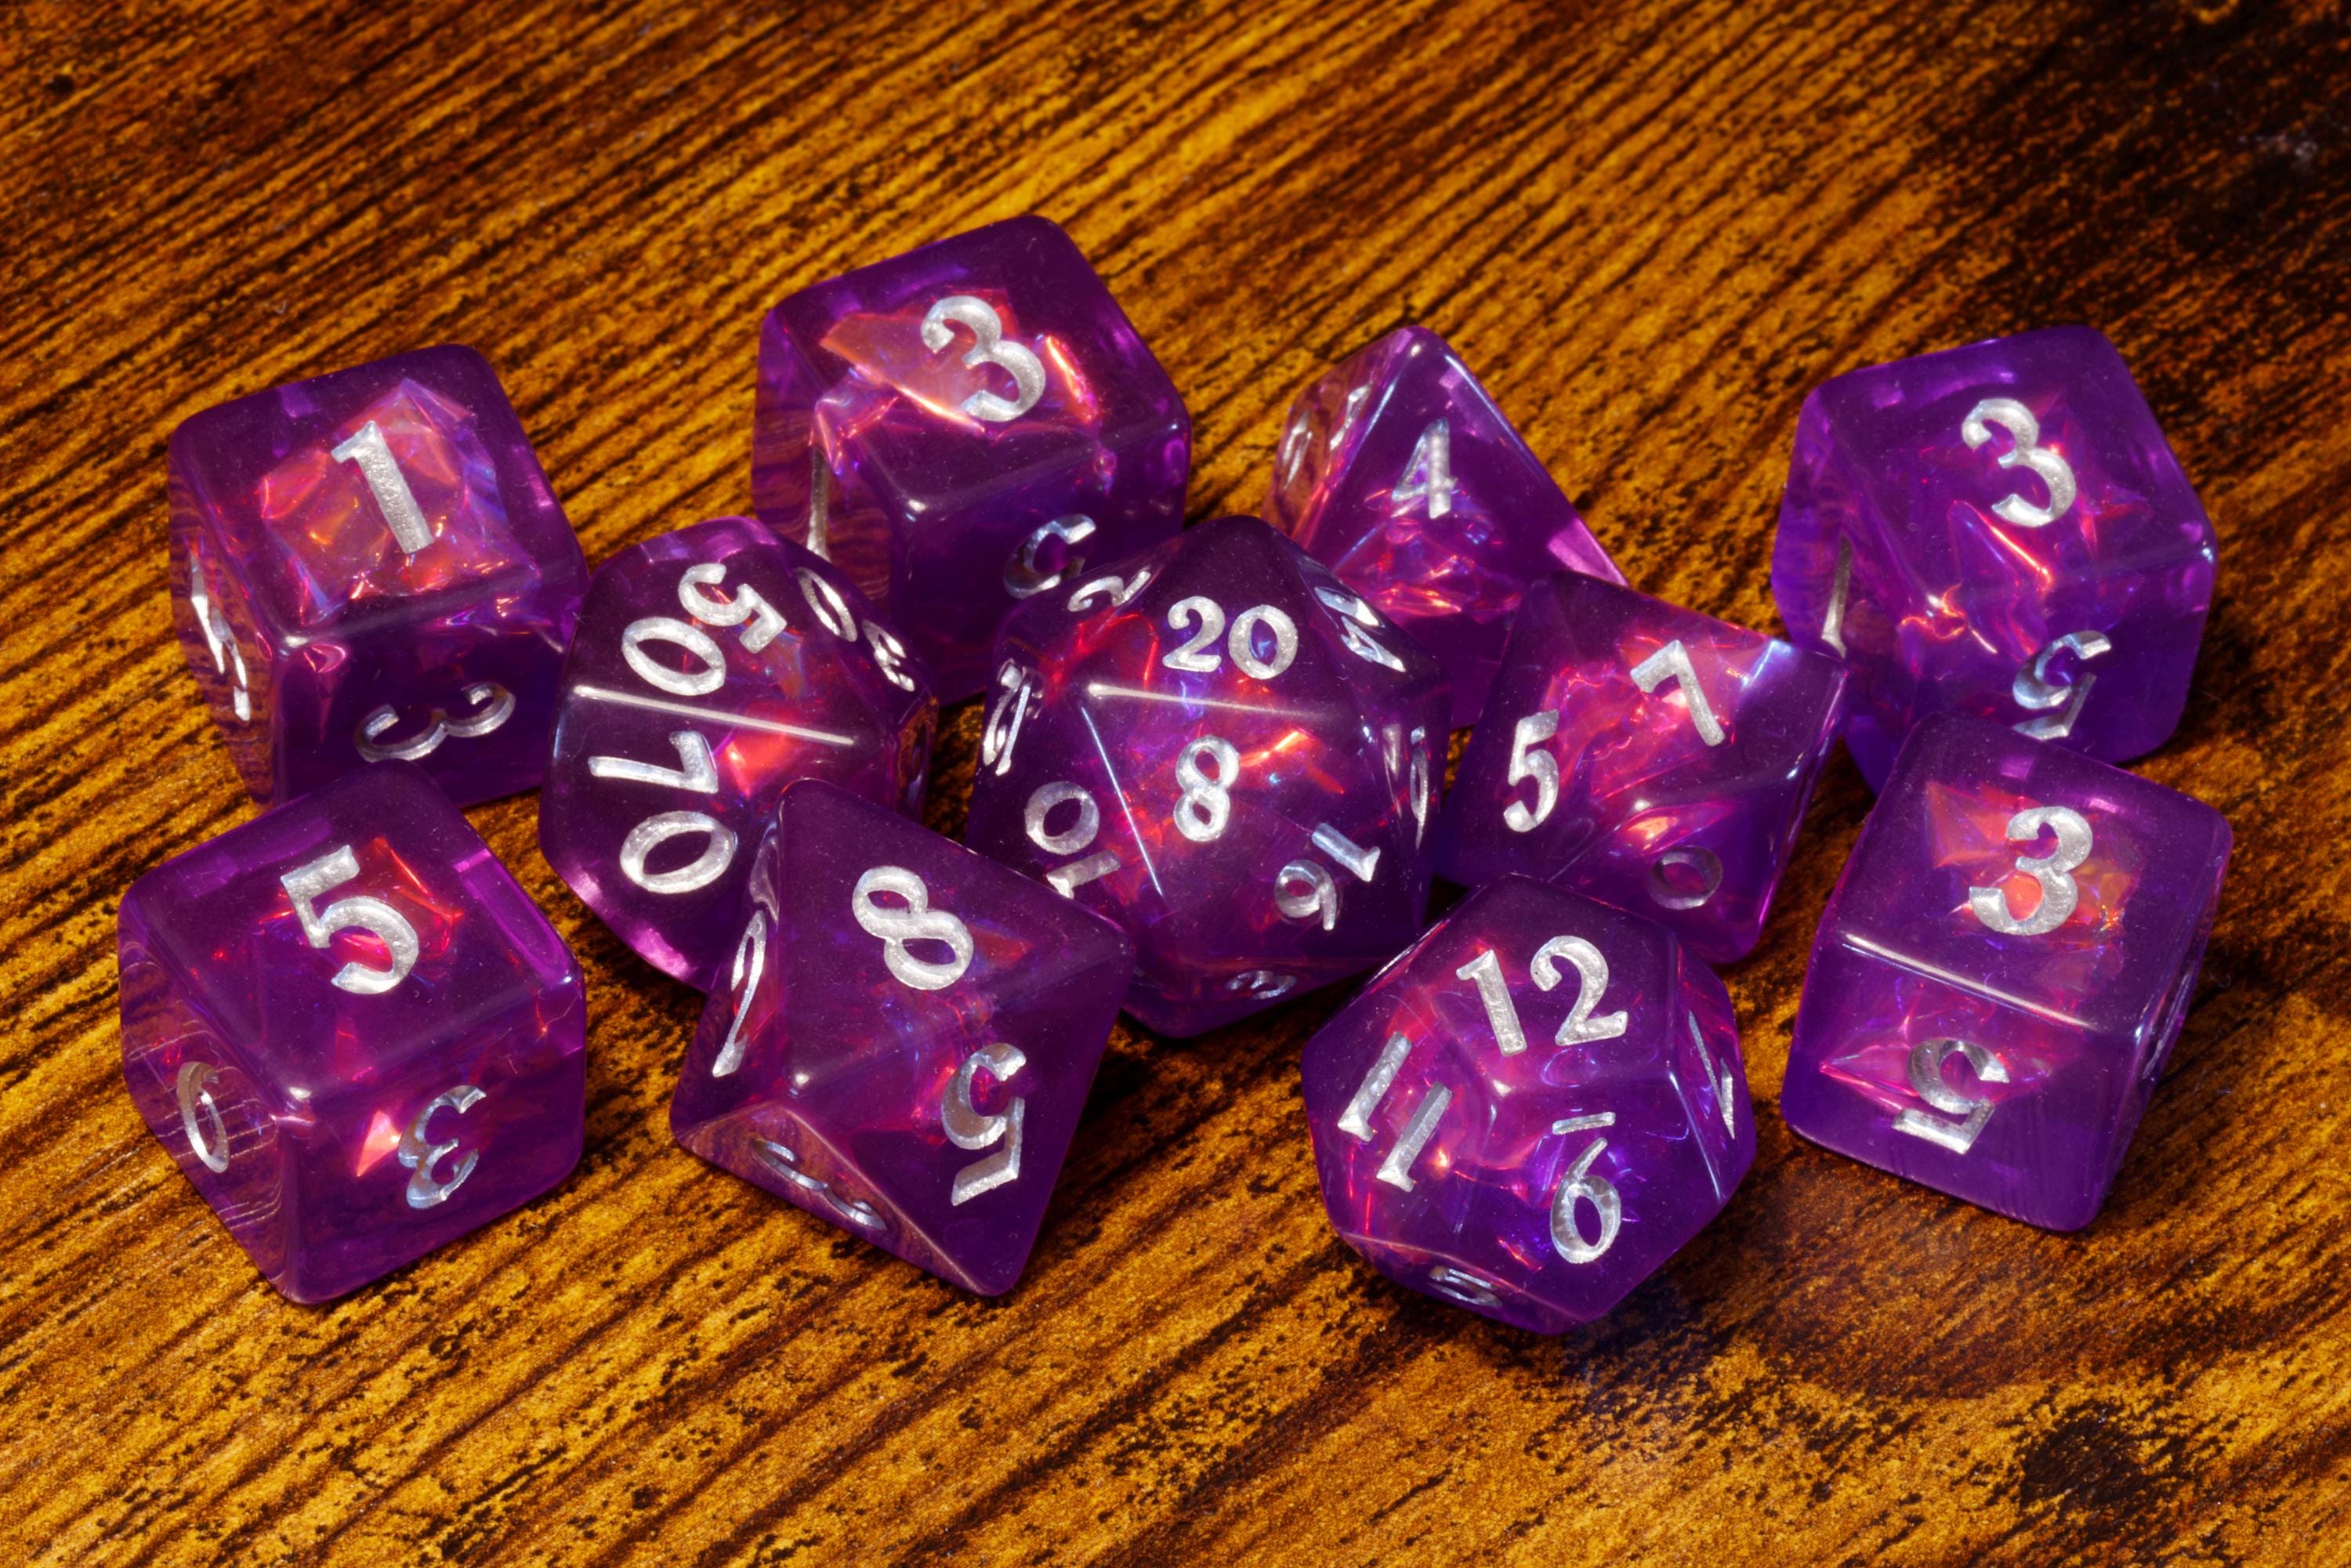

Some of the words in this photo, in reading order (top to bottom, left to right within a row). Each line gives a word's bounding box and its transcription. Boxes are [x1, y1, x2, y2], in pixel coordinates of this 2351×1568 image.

[921, 295, 1046, 422] 3
[331, 421, 434, 554] 1
[1392, 417, 1458, 520] 4
[1962, 398, 2077, 527] 3
[622, 563, 787, 696] 50
[1162, 596, 1299, 679] 20
[2012, 631, 2111, 741] 5
[355, 683, 516, 762] 3
[1630, 639, 1726, 747] 7
[588, 731, 735, 893] 70
[1173, 735, 1240, 842] 8
[1503, 709, 1559, 831] 5
[1025, 782, 1121, 899] 10
[1969, 806, 2093, 936] 3
[281, 845, 418, 994] 5
[853, 866, 973, 990] 8
[1456, 936, 1628, 1056] 12
[398, 1085, 487, 1209] 3
[941, 1042, 1026, 1206] 5
[1337, 1031, 1452, 1192] 11
[1892, 1037, 2010, 1154] 5
